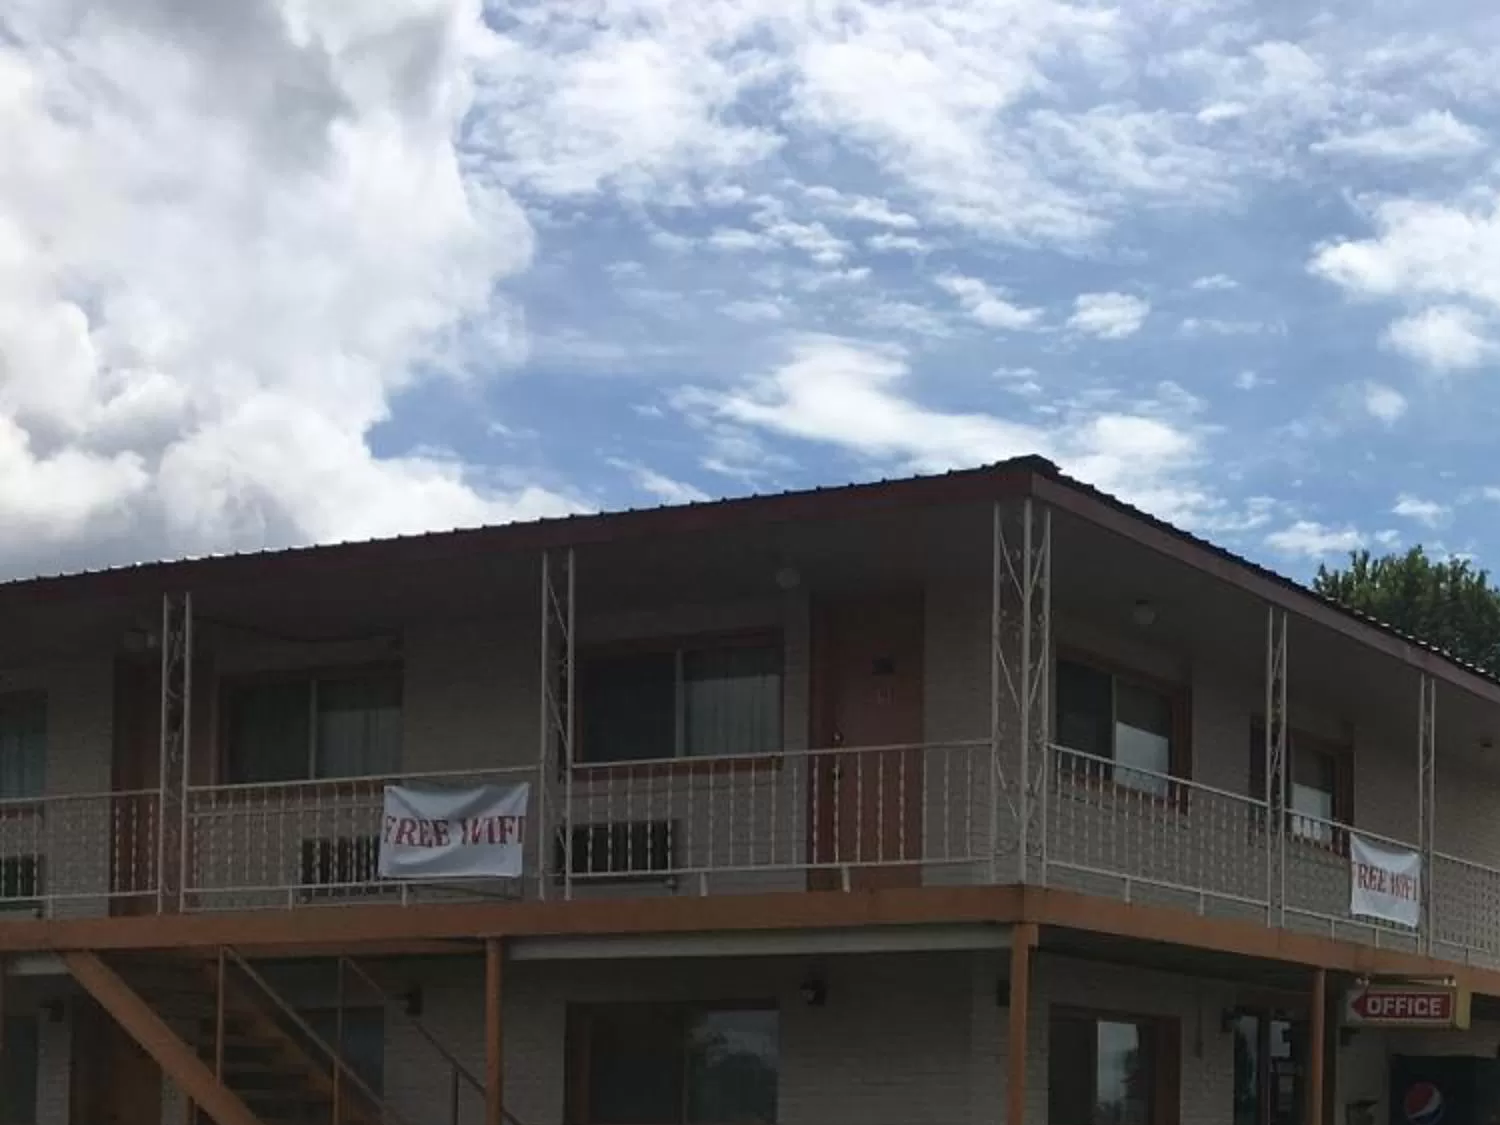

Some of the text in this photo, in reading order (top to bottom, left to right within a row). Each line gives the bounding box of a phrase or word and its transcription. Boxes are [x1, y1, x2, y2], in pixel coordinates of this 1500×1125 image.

[384, 815, 526, 847] FREE WIFI
[1352, 860, 1387, 893] FREE
[1367, 996, 1442, 1016] OFFICE
